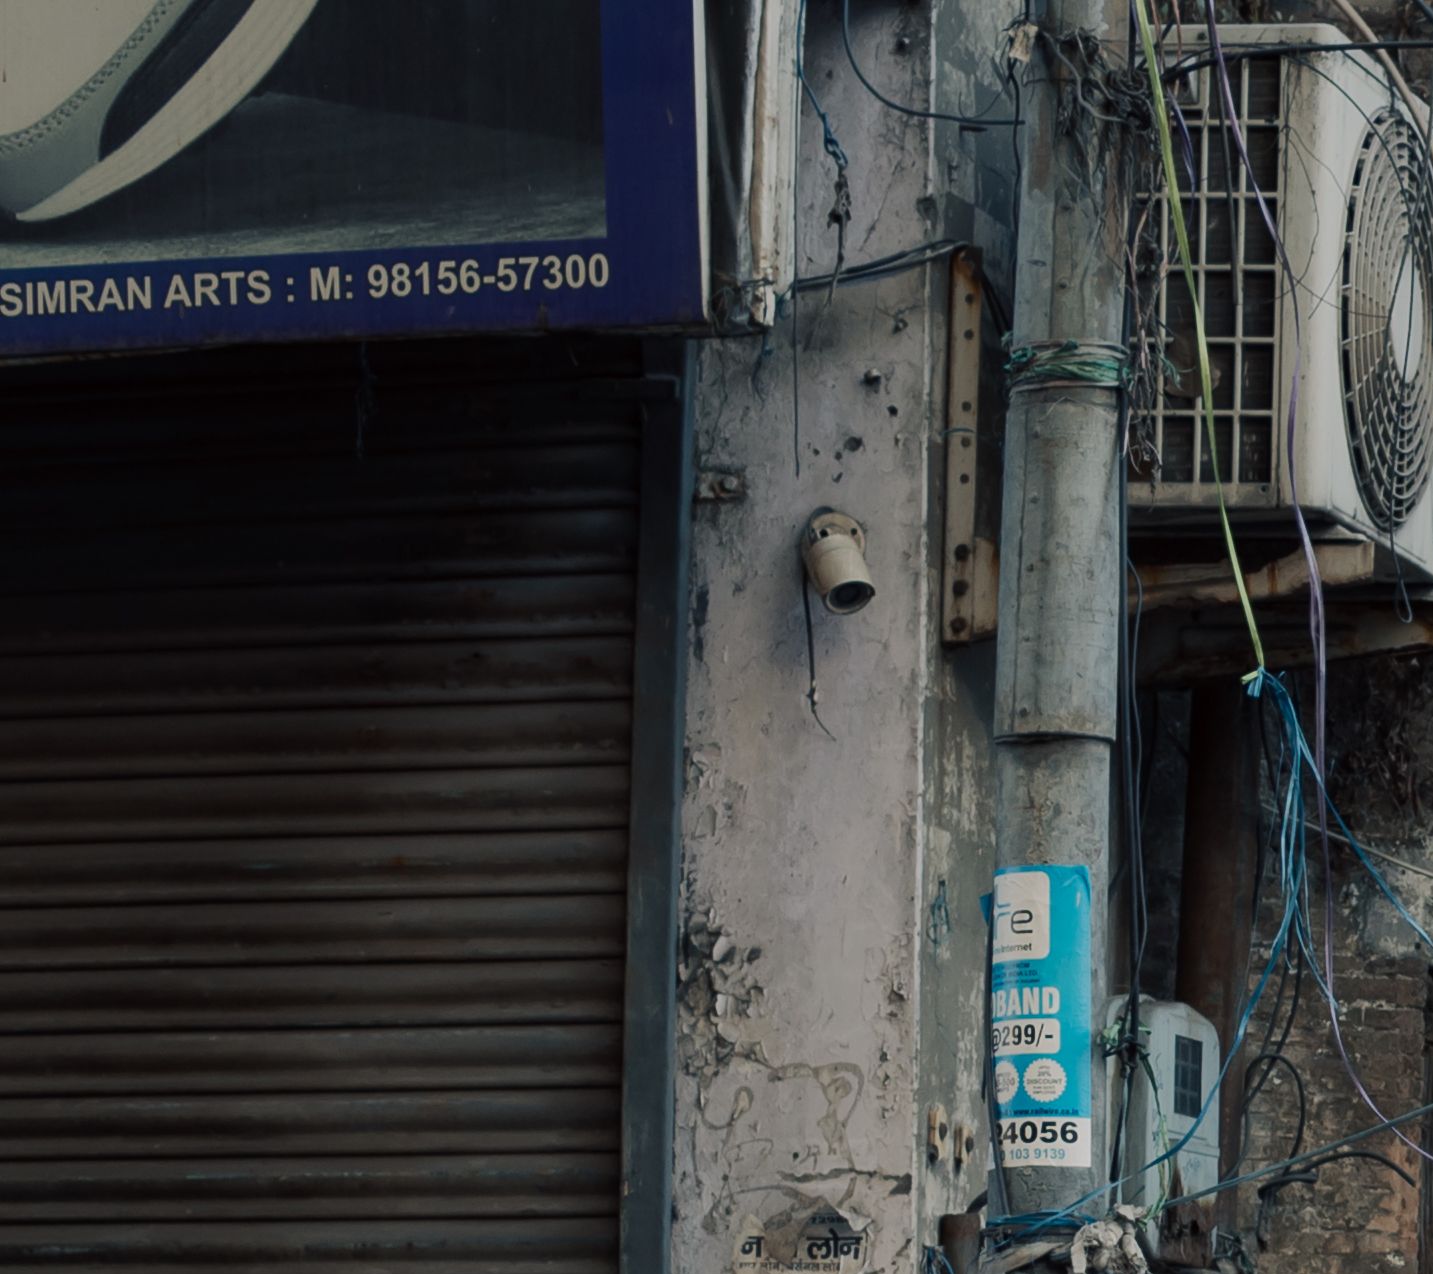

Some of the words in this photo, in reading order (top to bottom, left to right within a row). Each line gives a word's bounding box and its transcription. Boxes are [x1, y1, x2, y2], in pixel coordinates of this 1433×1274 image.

[0, 280, 152, 317] SIMRAN
[164, 269, 273, 309] ARTS
[368, 252, 610, 299] 98156-57300
